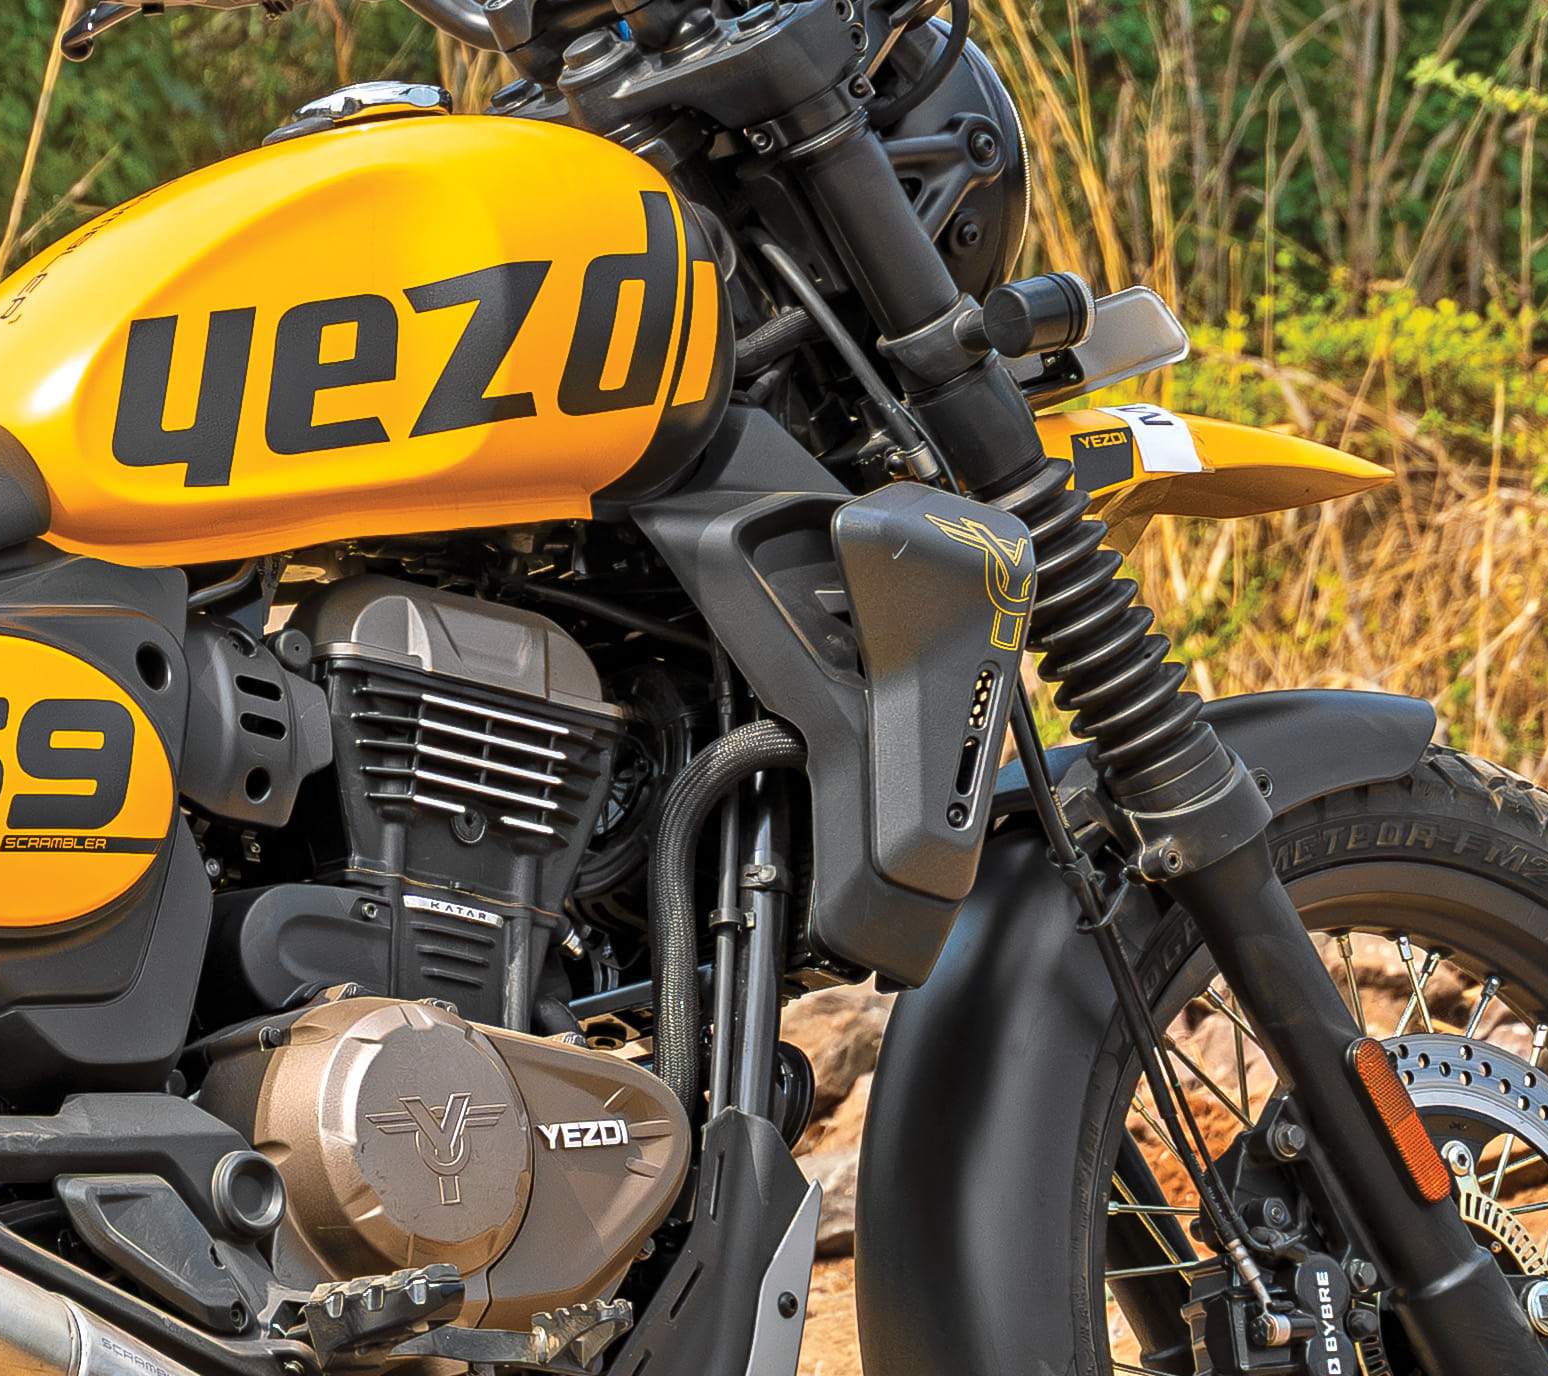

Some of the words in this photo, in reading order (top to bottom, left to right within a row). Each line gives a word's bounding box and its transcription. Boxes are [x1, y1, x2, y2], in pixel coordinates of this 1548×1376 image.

[1078, 431, 1128, 449] YEZDI
[4, 836, 107, 851] SCRAMBLER
[429, 899, 490, 923] KATAR
[536, 1118, 629, 1151] YEZDI
[1316, 1271, 1338, 1352] BYBRE
